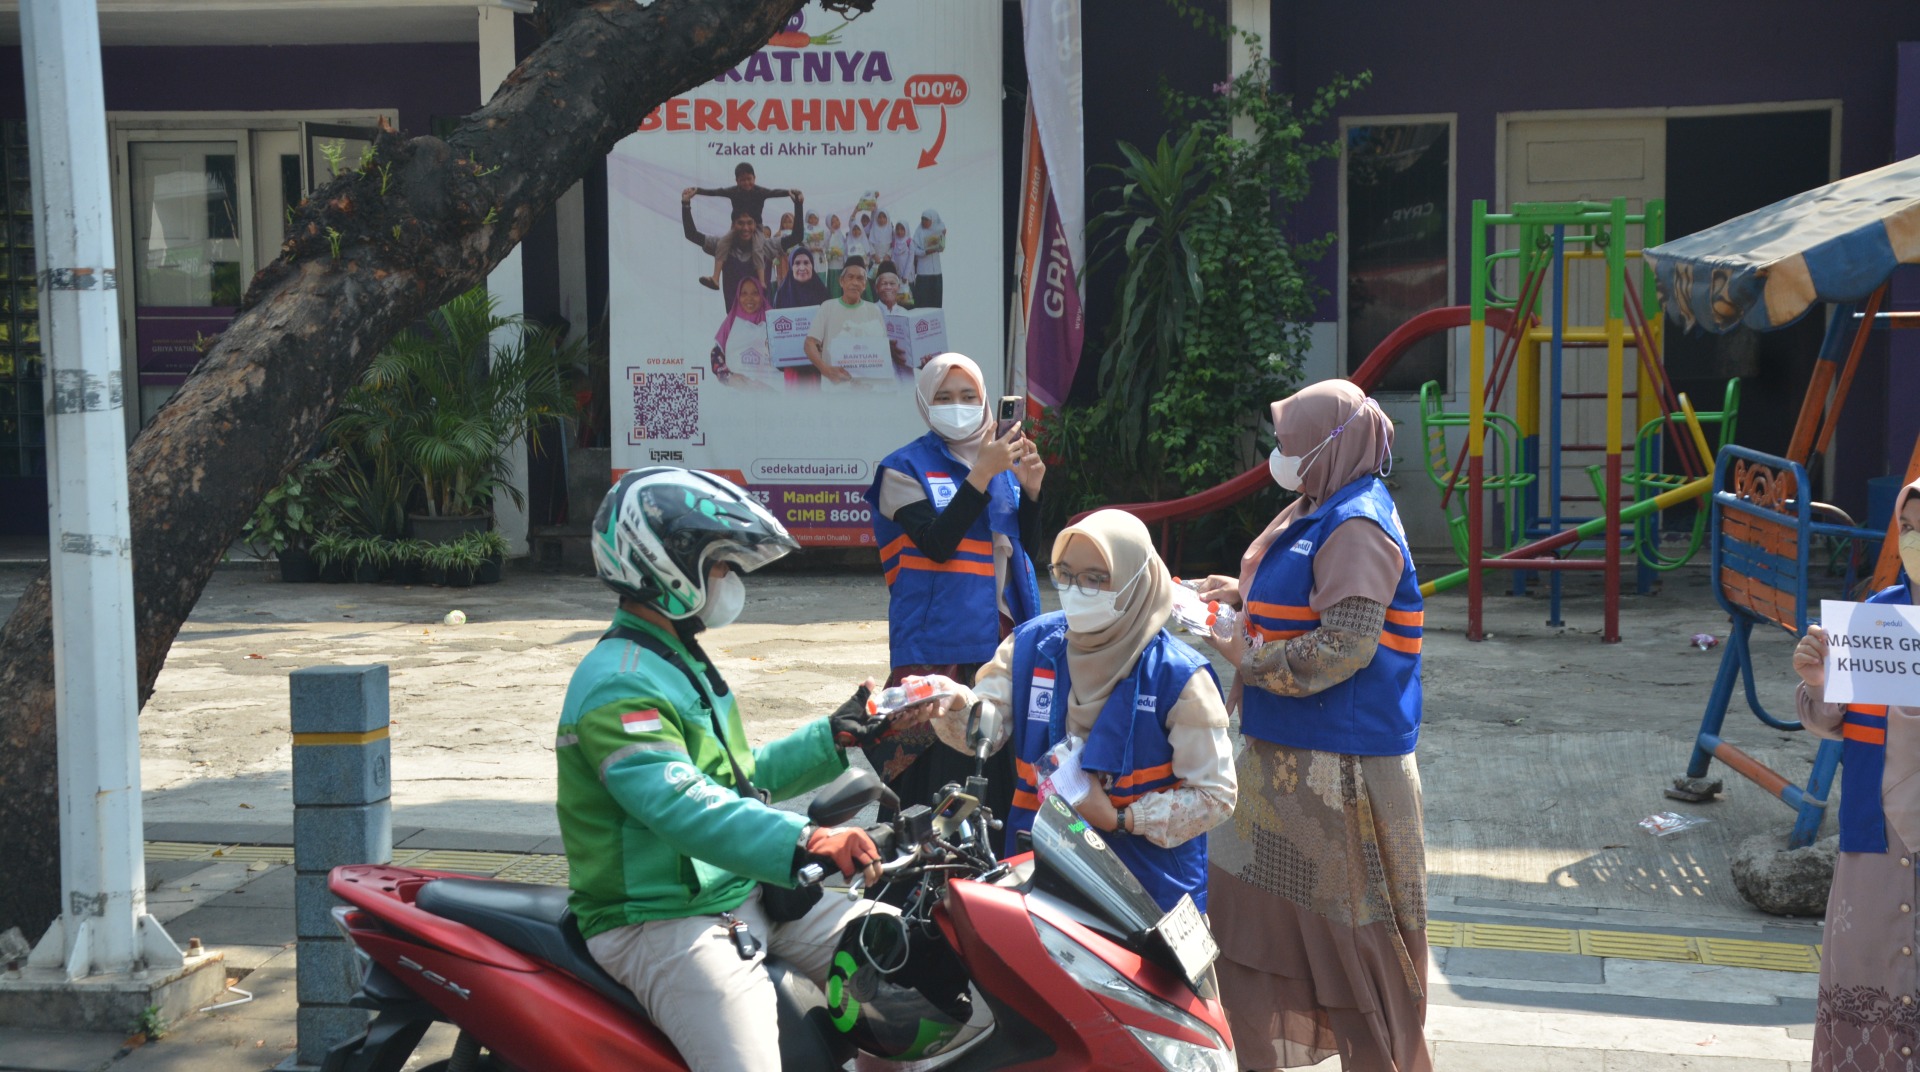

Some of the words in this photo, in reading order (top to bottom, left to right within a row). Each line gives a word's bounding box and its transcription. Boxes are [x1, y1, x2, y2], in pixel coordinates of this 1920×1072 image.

[909, 81, 962, 98] 100%
[637, 98, 919, 132] BERKAHNYA
[759, 142, 774, 156] di
[779, 142, 815, 156] Akhir
[761, 463, 858, 475] sedekatduajari.id
[783, 490, 840, 503] Mandiri
[786, 509, 826, 522] CIMB
[830, 509, 871, 522] 8600
[1826, 633, 1894, 650] MASKER
[1838, 658, 1907, 675] KHUSUS
[398, 955, 471, 1000] PCX
